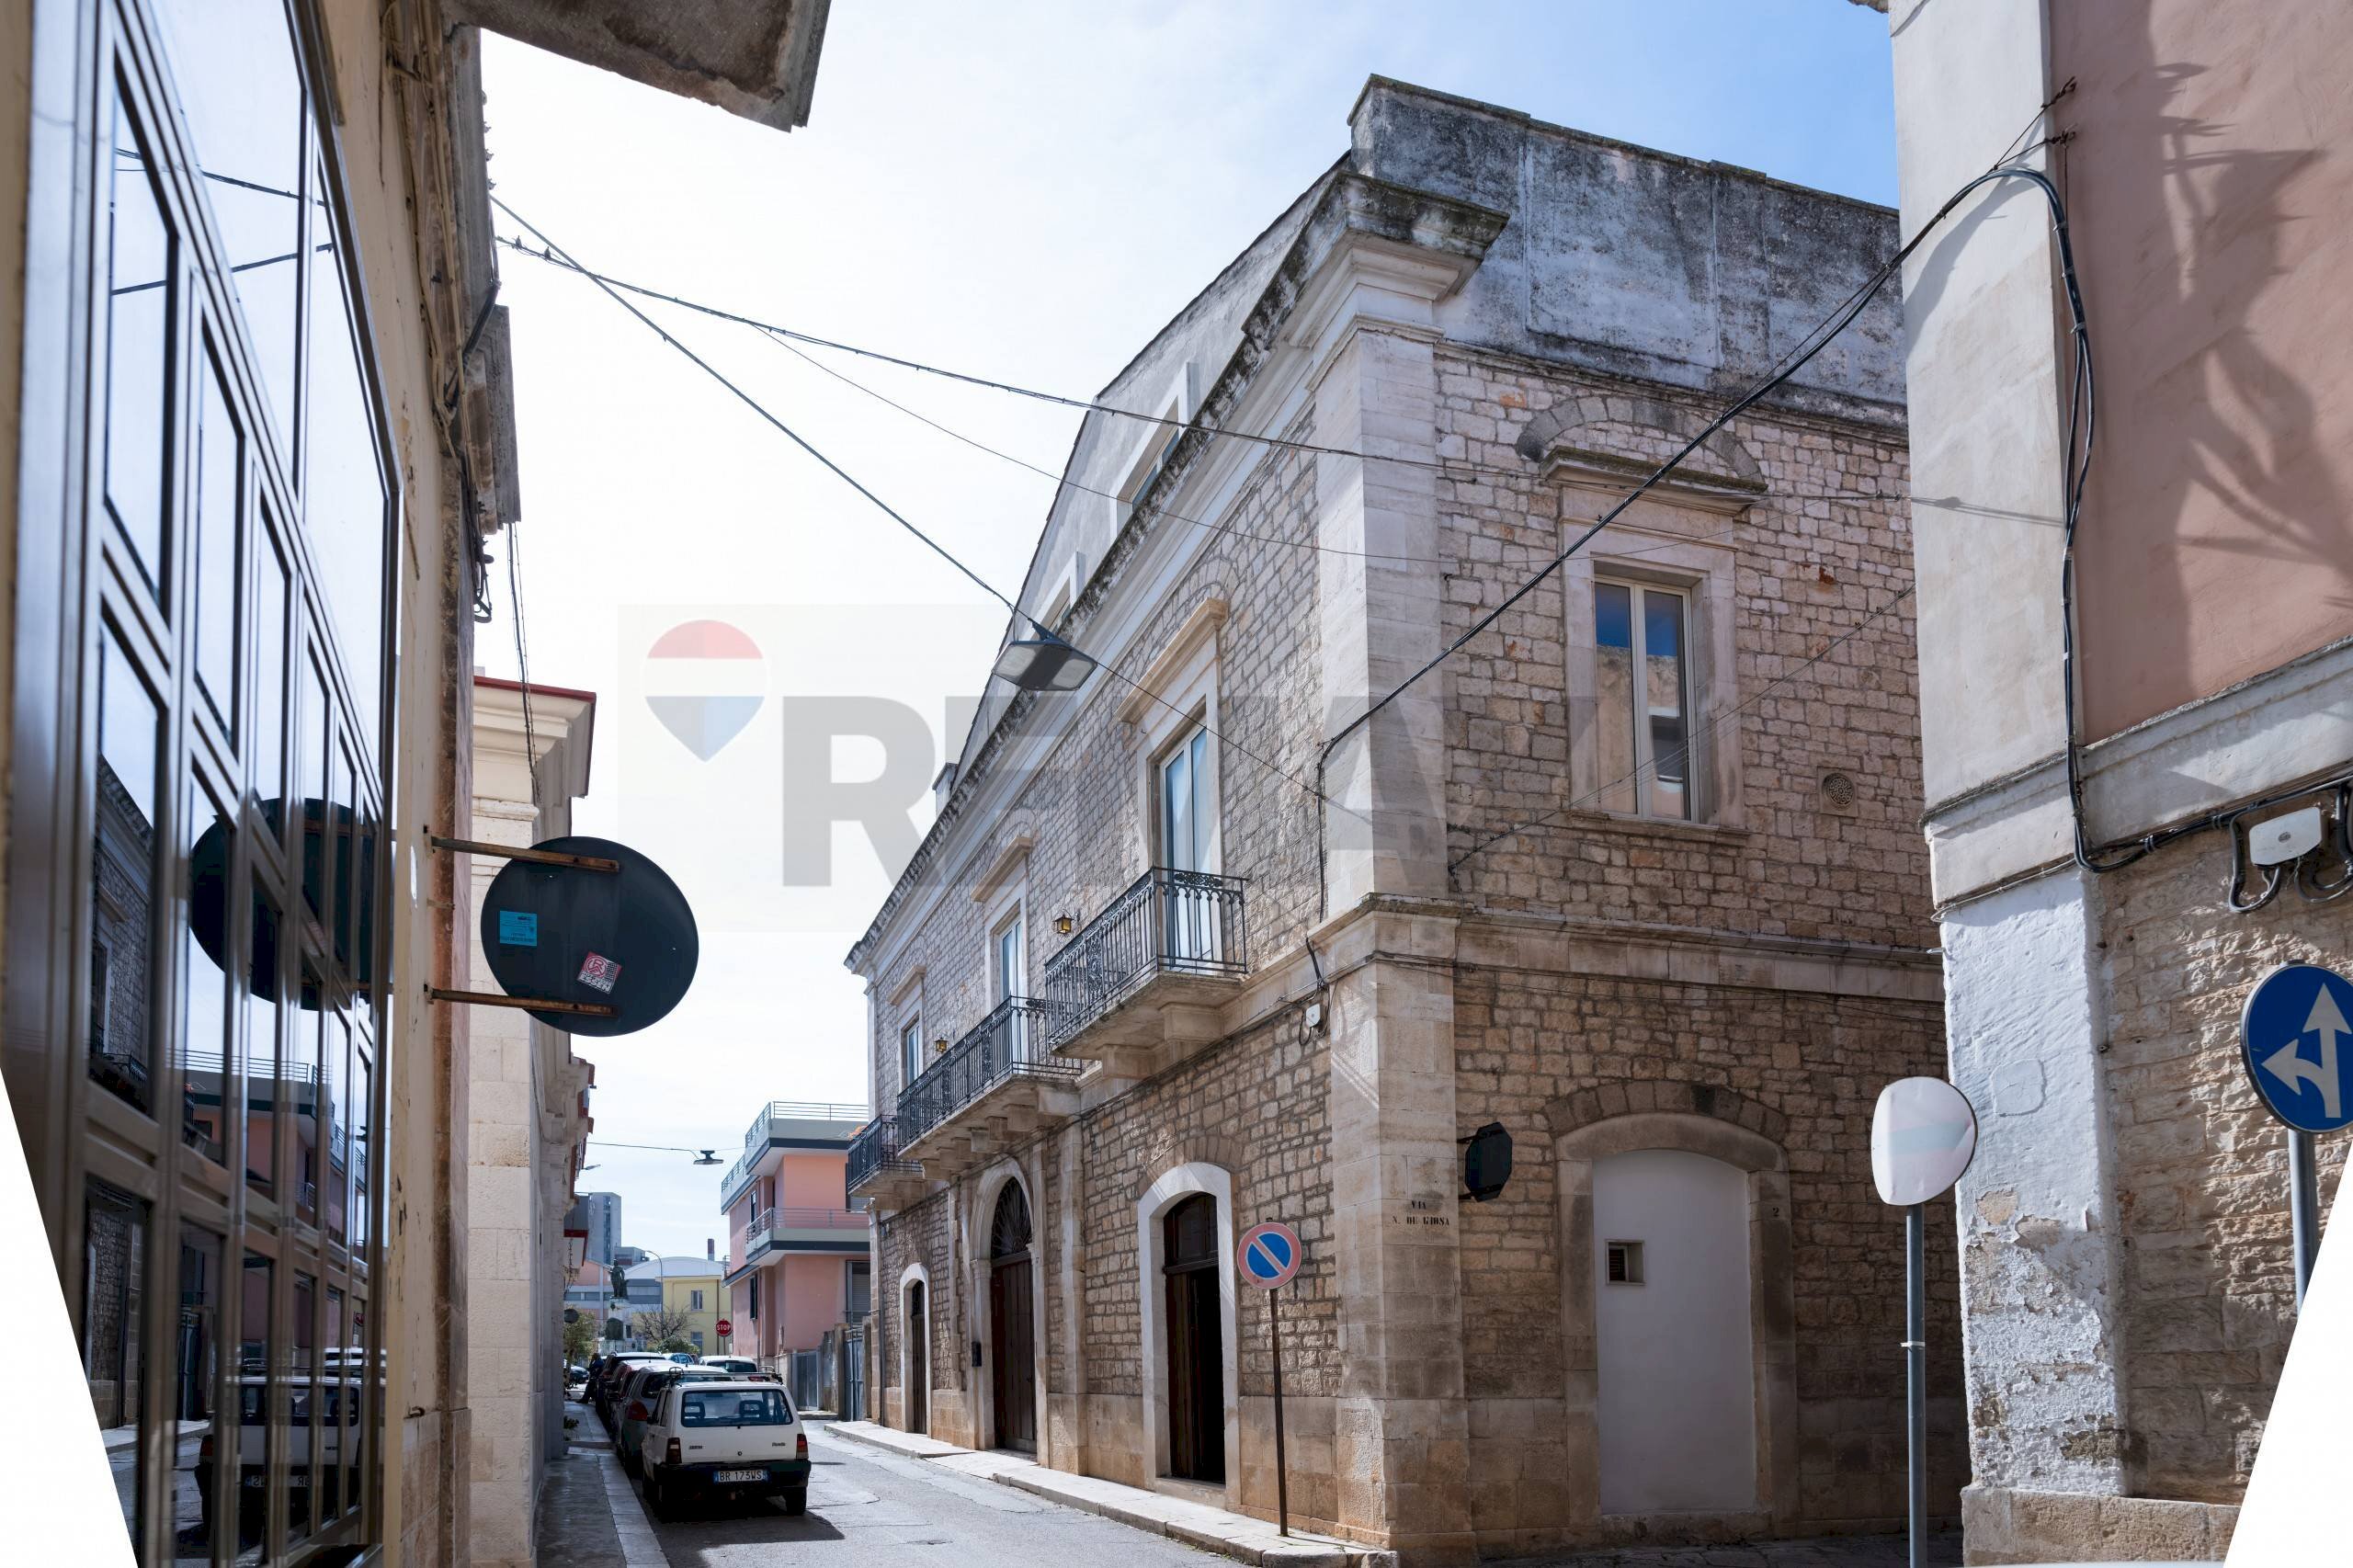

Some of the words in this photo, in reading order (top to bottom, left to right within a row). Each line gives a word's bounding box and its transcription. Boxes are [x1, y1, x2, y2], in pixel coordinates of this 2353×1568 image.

[1411, 1200, 1427, 1210] VIA
[1772, 1207, 1779, 1217] 2
[719, 1471, 731, 1482] BR
[734, 1471, 763, 1481] 173WS
